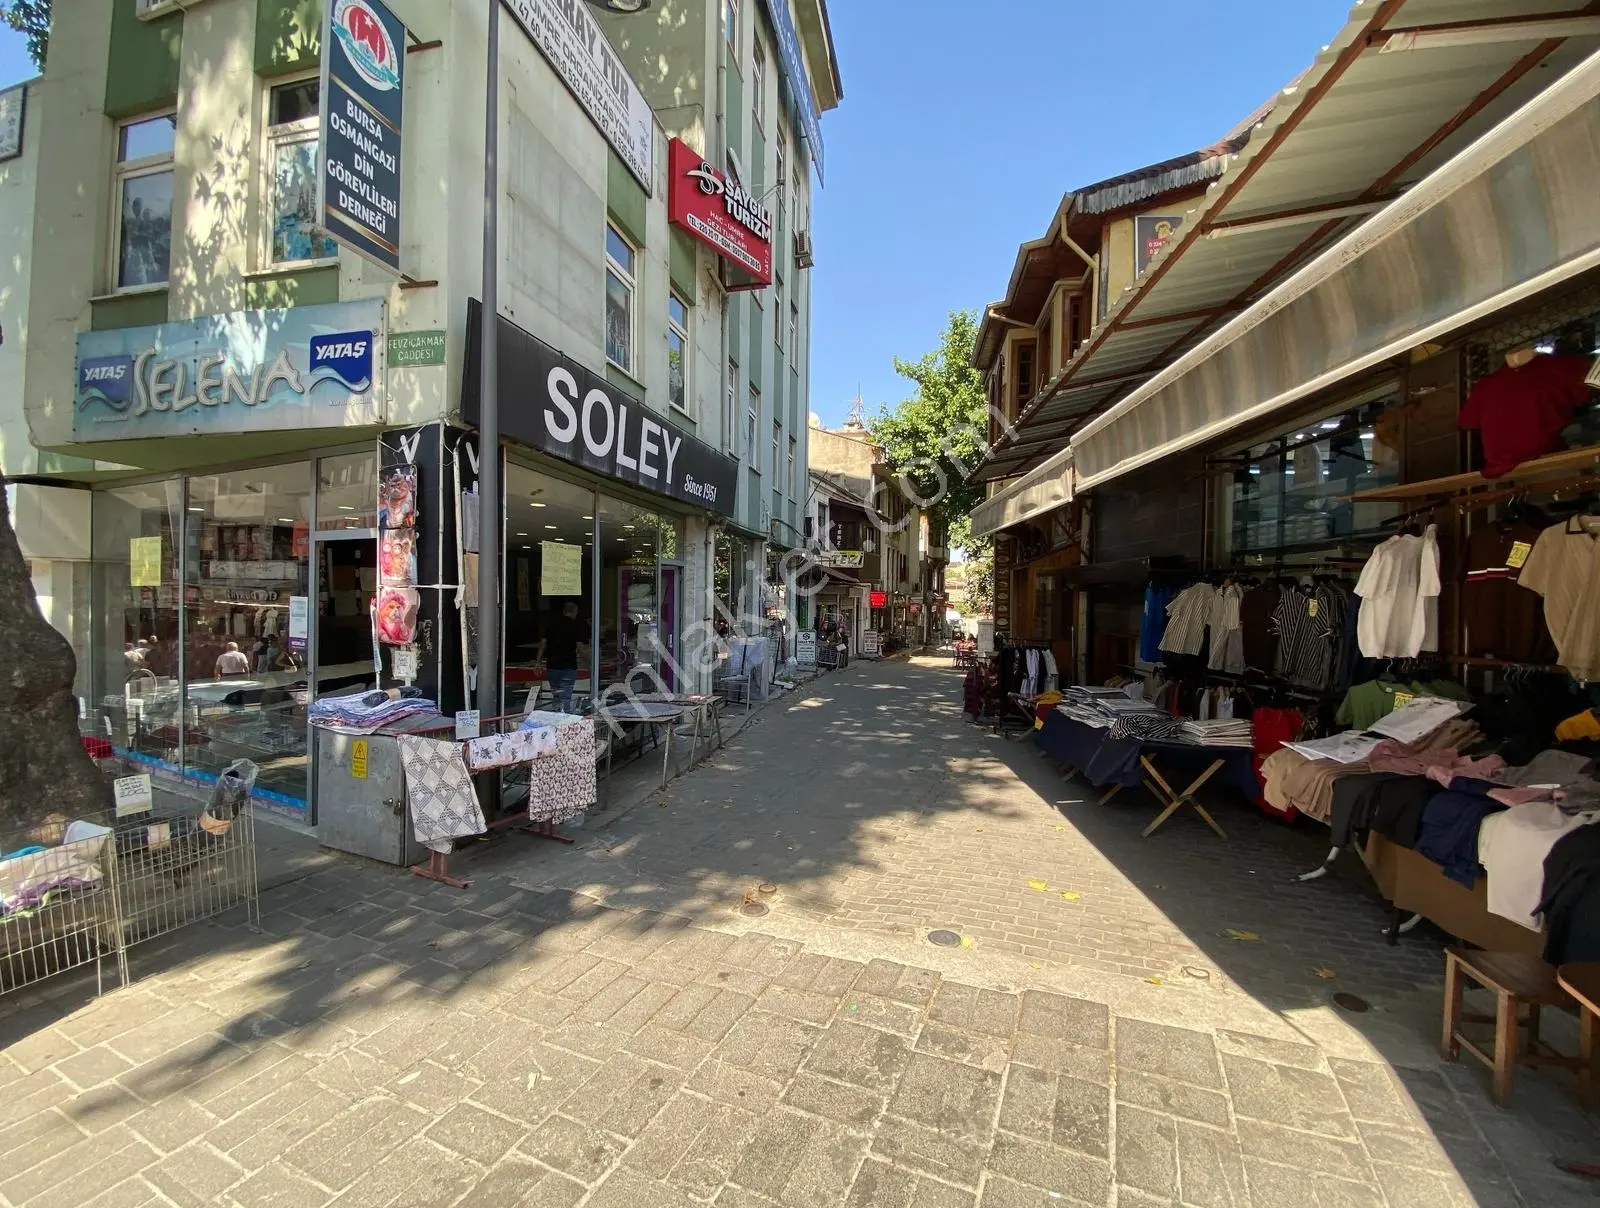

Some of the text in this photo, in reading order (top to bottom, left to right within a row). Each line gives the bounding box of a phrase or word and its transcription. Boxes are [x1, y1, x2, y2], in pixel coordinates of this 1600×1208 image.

[555, 0, 629, 112] RAY TUR
[346, 99, 383, 142] BURSA
[330, 112, 396, 174] OSMANGAZİ
[354, 153, 374, 180] DİN
[327, 159, 397, 219] GÖREVLİLERİ
[339, 190, 386, 234] DERNEĞİ
[316, 341, 367, 360] YATAŞ
[84, 365, 126, 381] YATAŞ
[133, 346, 305, 417] SELENA
[544, 366, 682, 485] SOLEY
[684, 473, 717, 502] Since 1951
